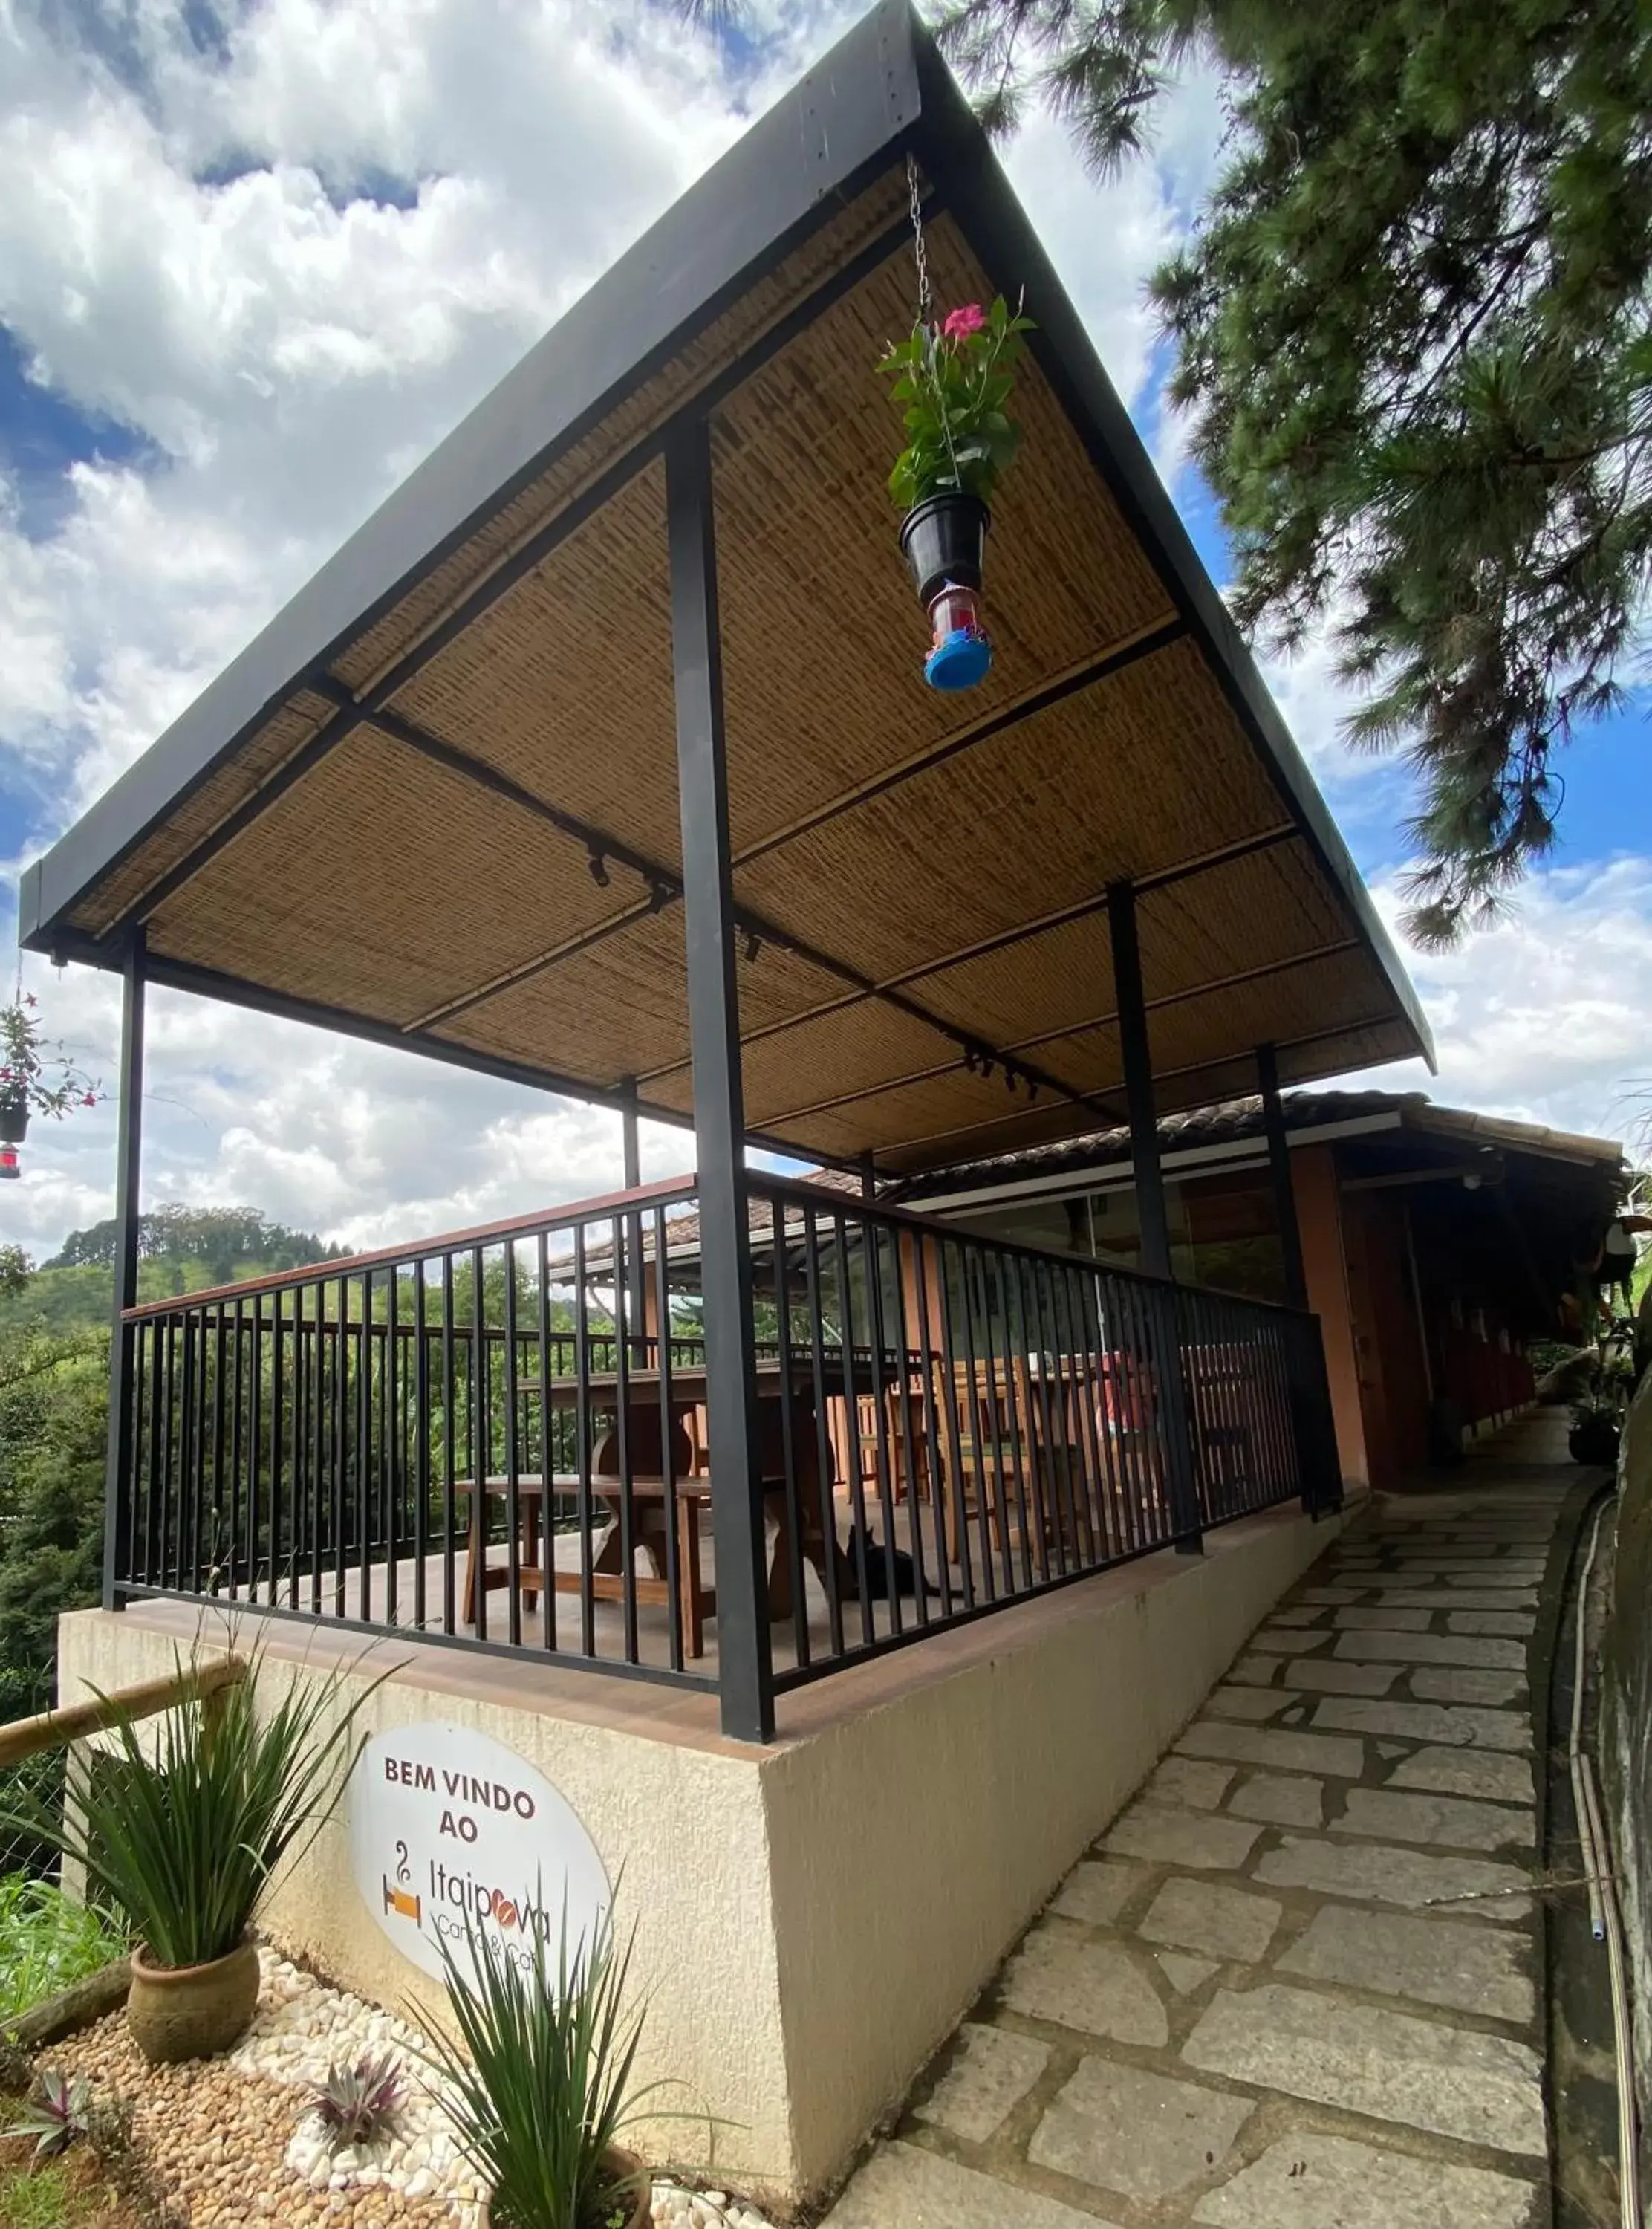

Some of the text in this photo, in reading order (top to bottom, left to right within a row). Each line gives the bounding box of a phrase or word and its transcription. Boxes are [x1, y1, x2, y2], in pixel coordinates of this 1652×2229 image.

[385, 1756, 535, 1820] BEM VINDO
[439, 1810, 478, 1843] AO
